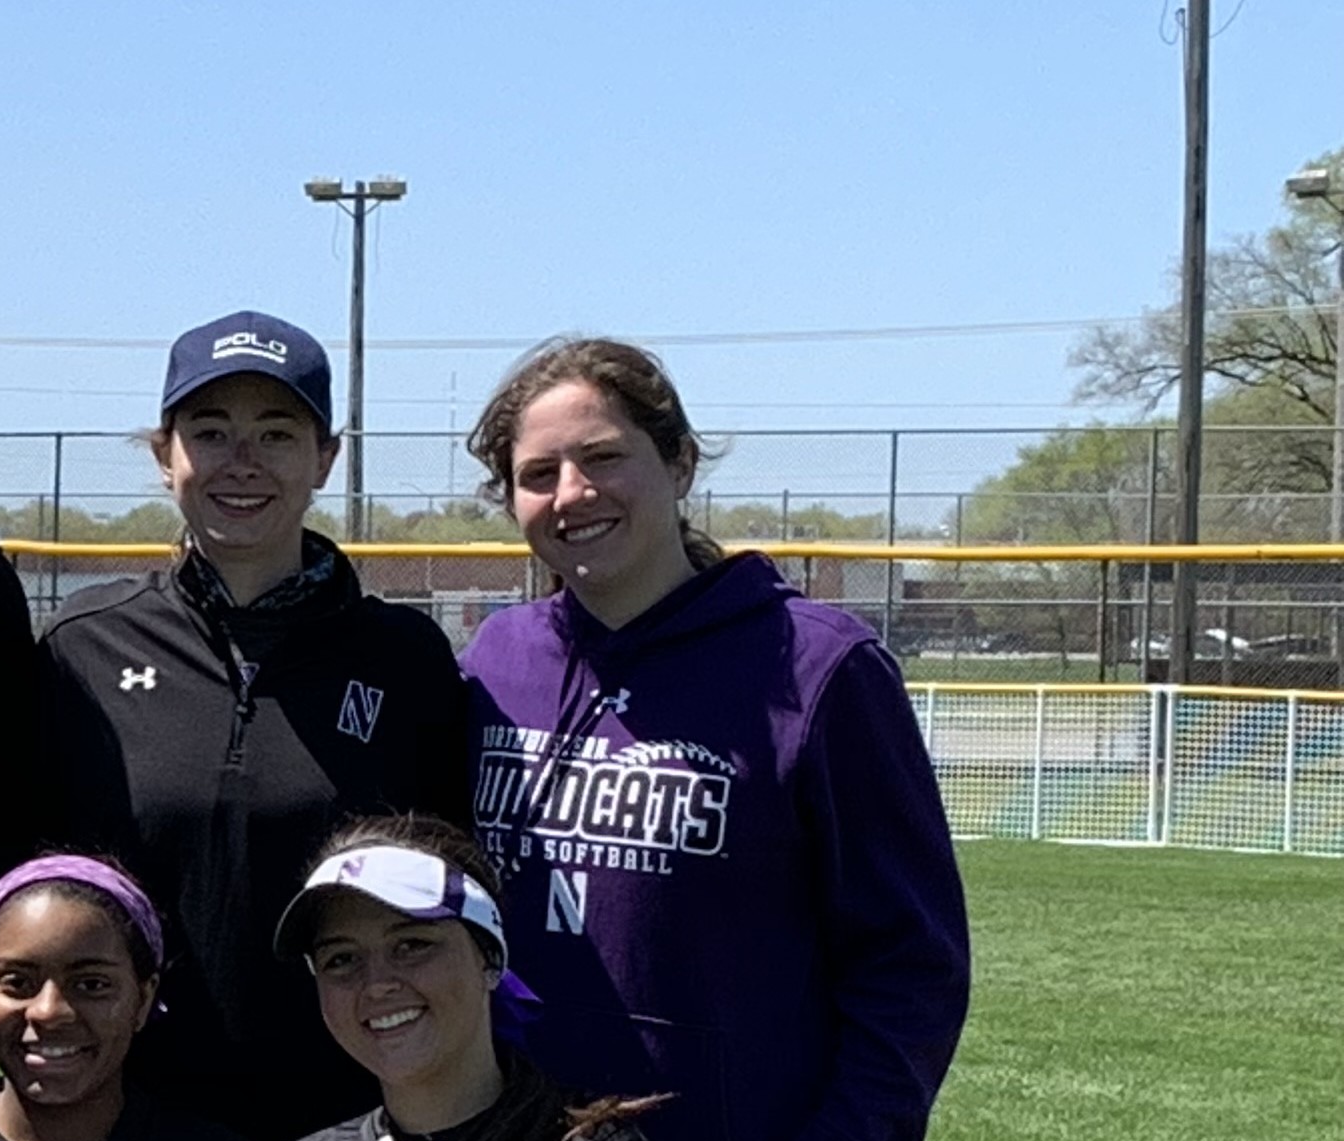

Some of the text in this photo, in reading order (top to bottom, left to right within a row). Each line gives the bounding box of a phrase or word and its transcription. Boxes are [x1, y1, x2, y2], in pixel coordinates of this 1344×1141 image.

[214, 331, 288, 355] POLO
[337, 679, 384, 743] N
[544, 838, 673, 875] SOFTBALL
[546, 868, 588, 935] N
